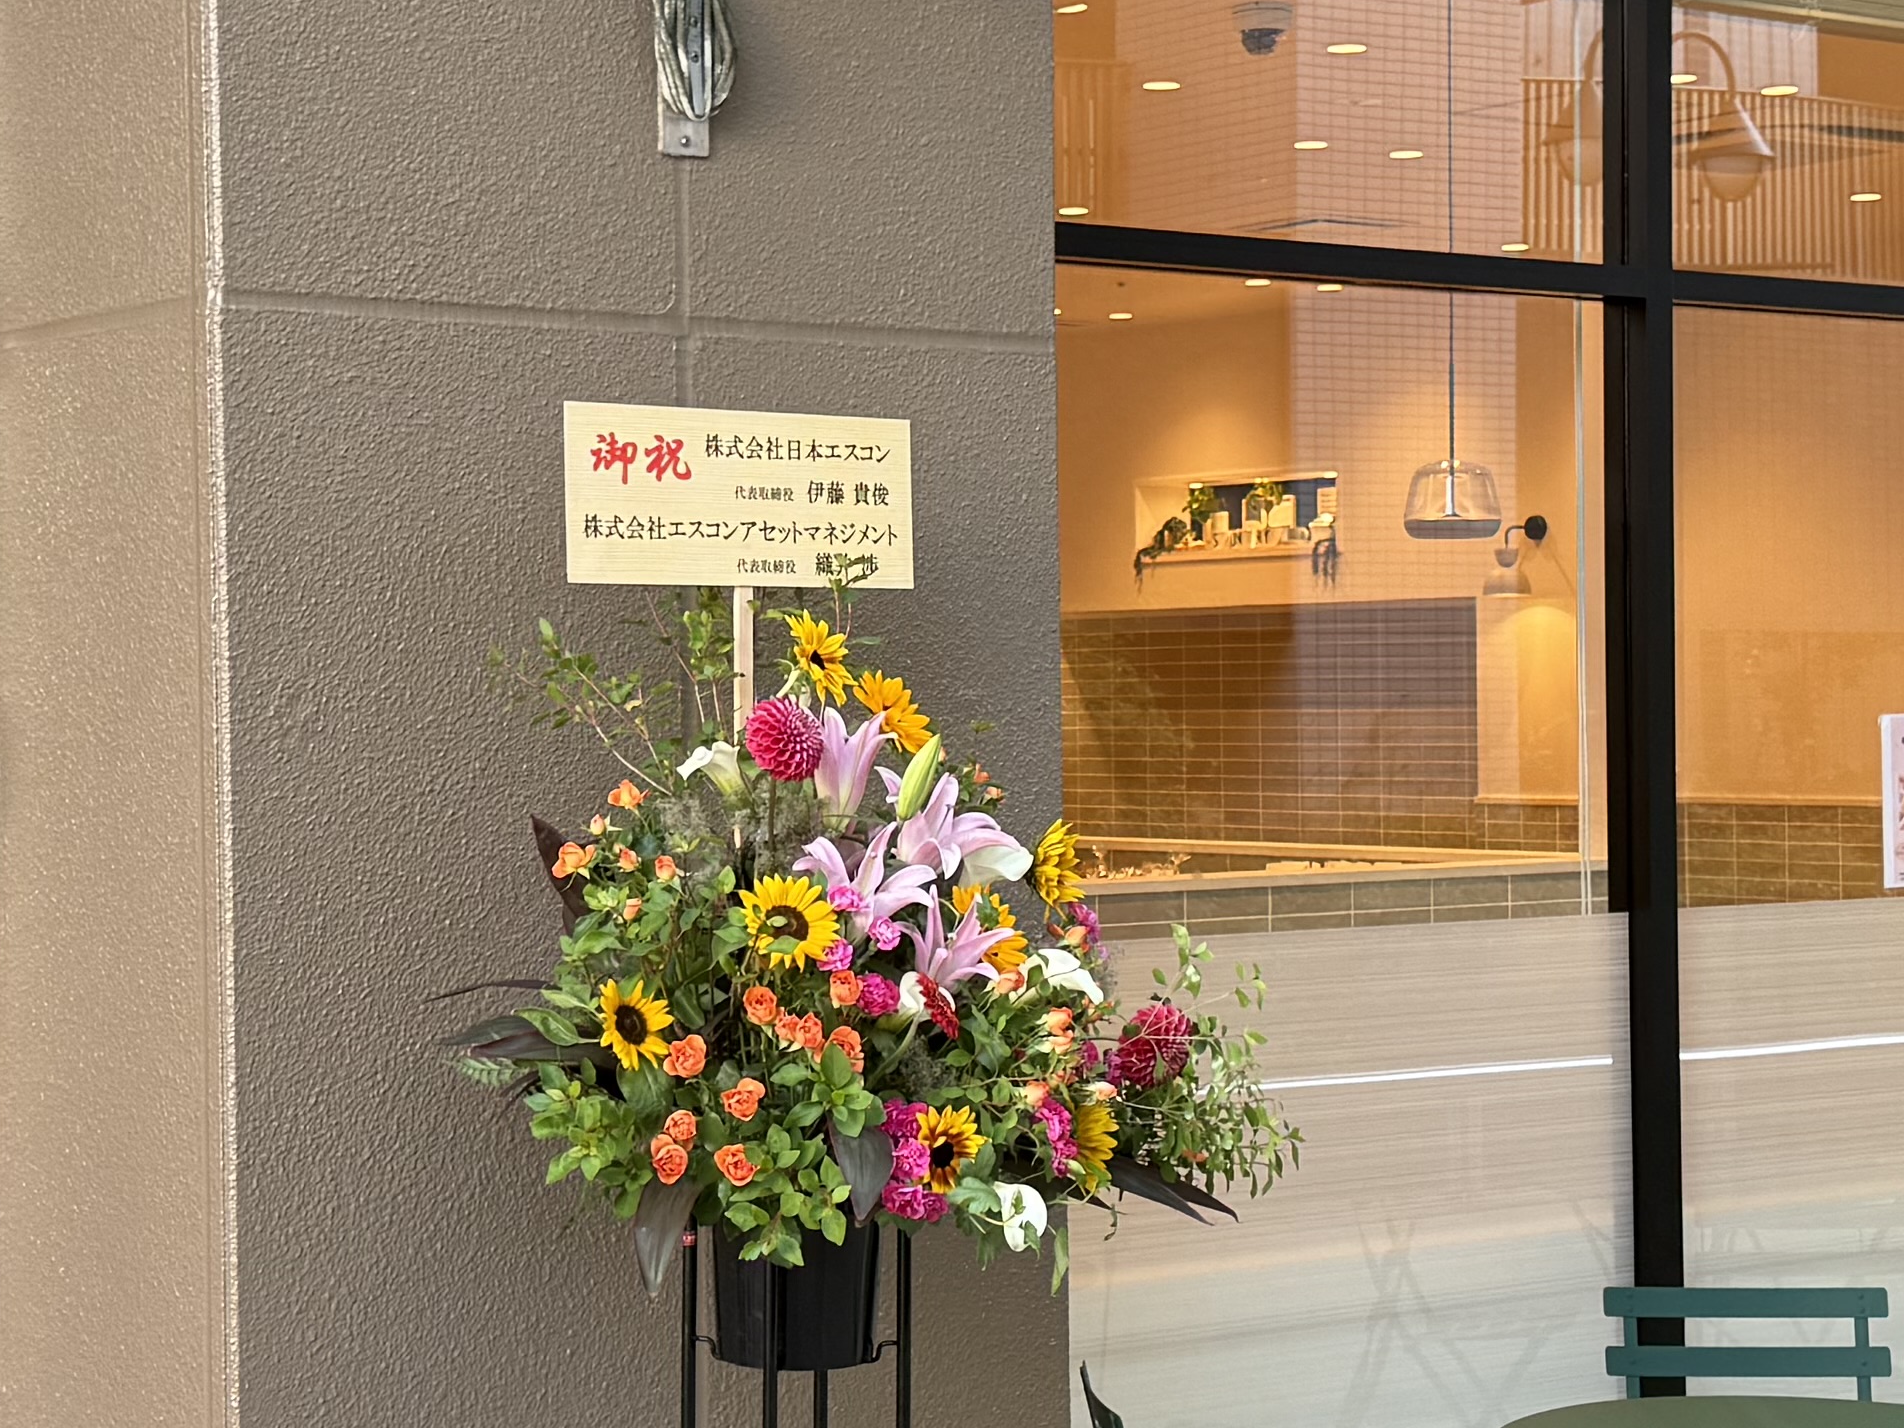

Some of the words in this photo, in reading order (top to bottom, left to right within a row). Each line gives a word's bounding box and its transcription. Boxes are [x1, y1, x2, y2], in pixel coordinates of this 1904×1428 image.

[590, 432, 692, 484] 御祝
[704, 433, 891, 463] 株式会社日本エスコン
[735, 485, 794, 502] 代表取締役
[584, 513, 898, 547] 株式会社エスコンアセットマネジメント
